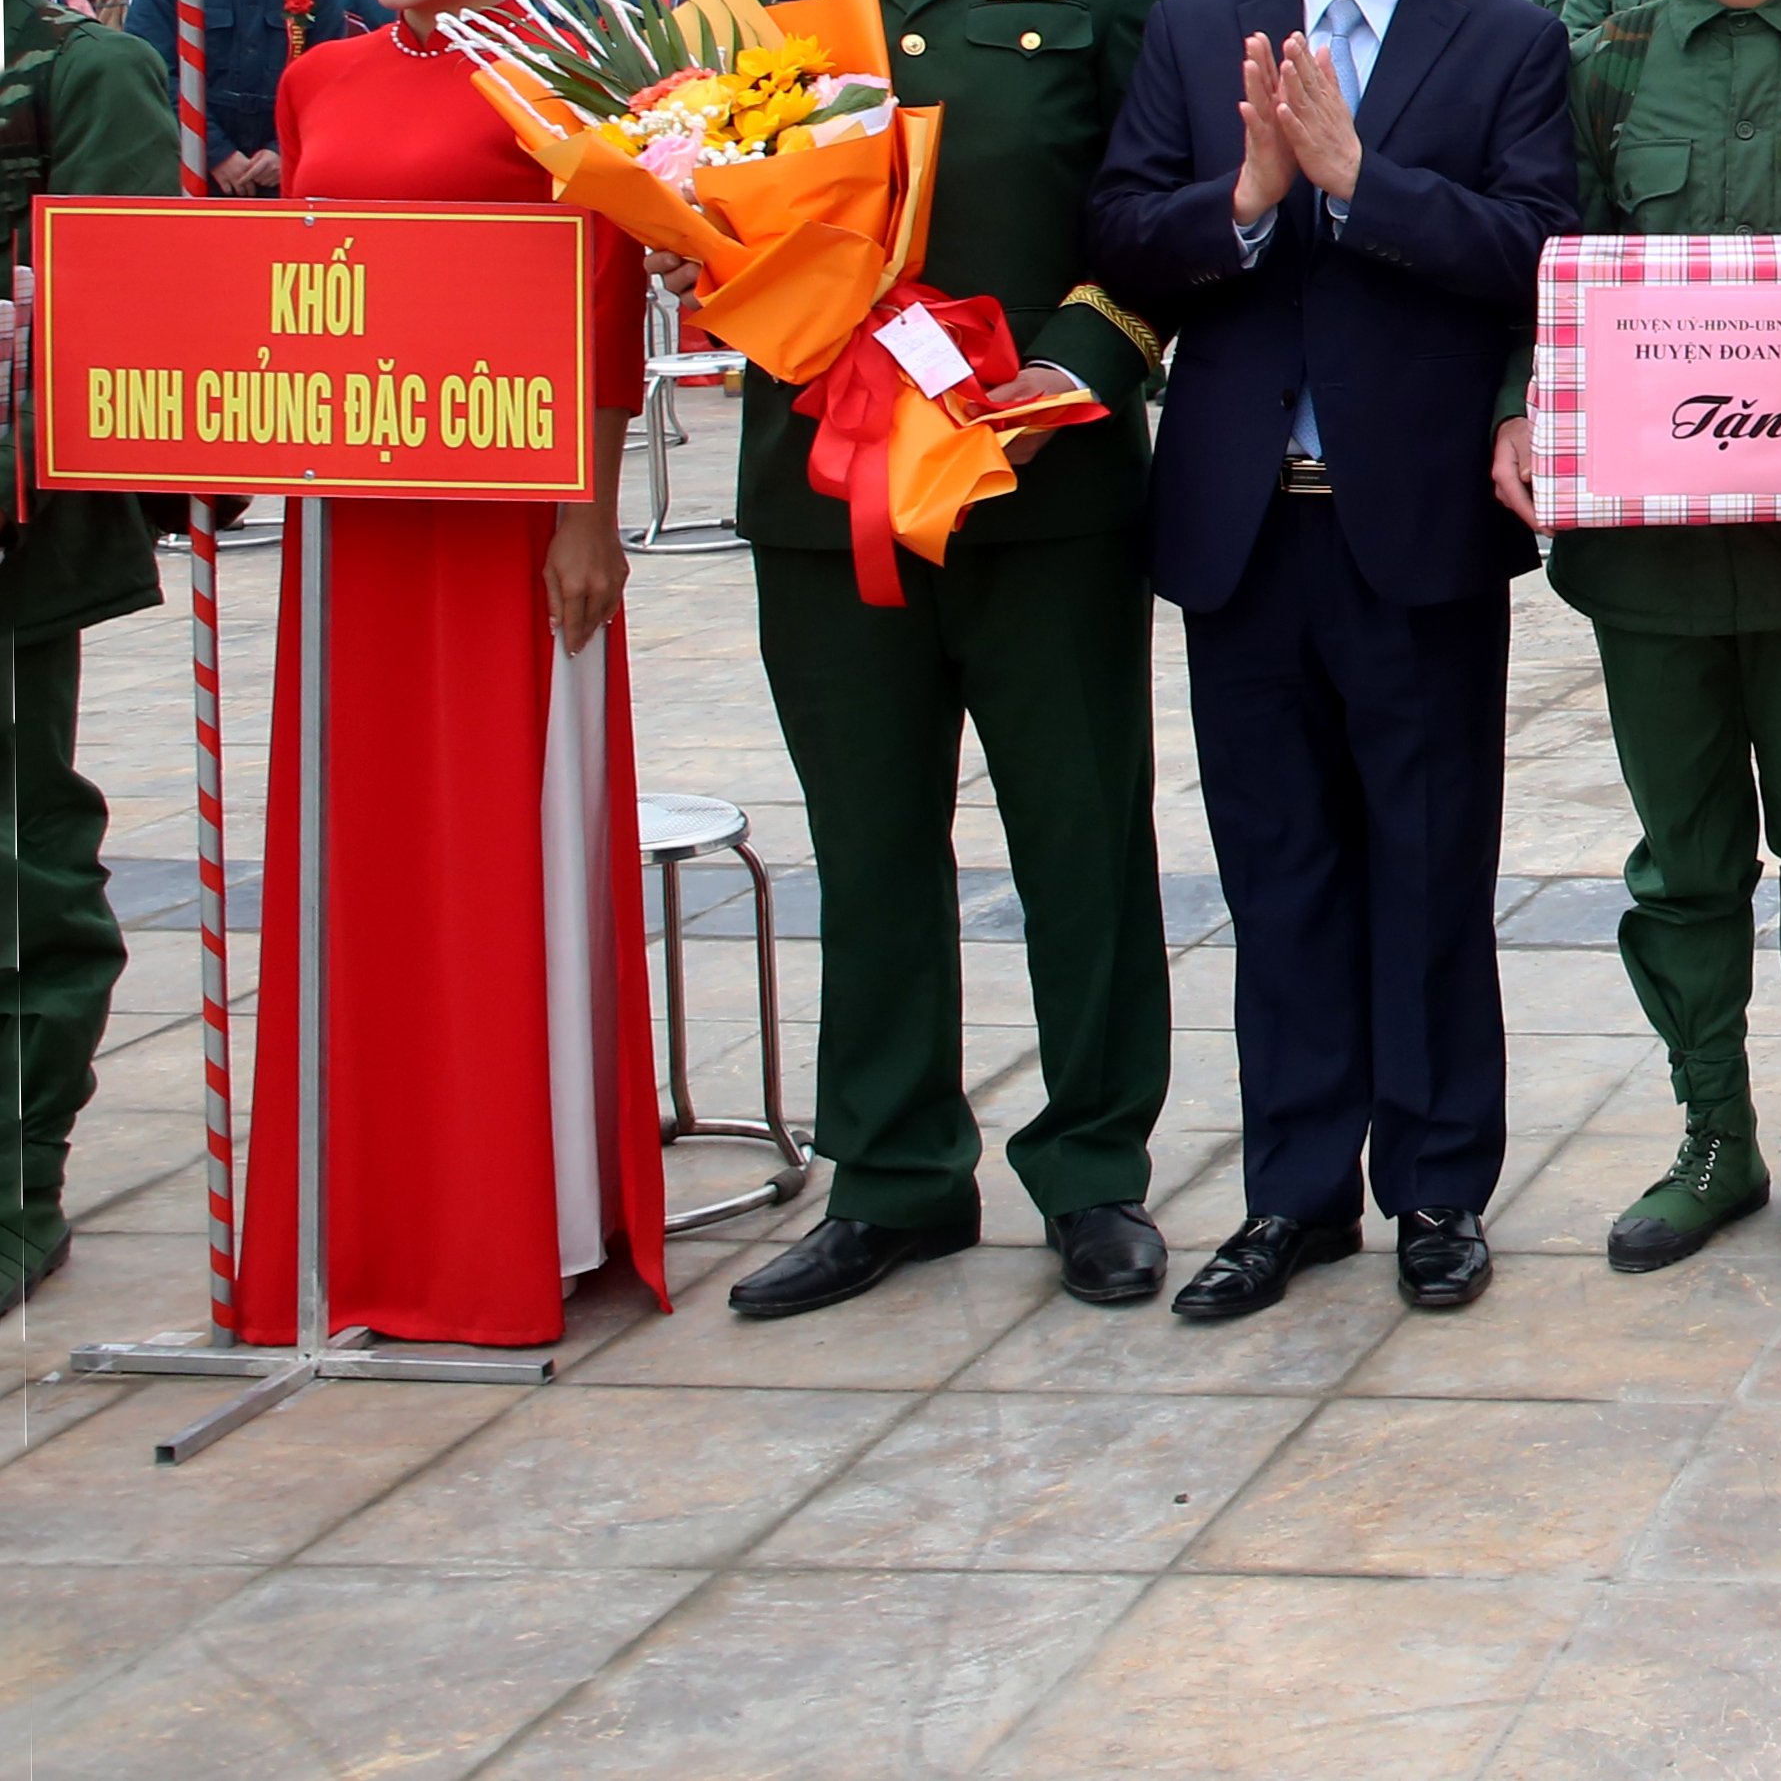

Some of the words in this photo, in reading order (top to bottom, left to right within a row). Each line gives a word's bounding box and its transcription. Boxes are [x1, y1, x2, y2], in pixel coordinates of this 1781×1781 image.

[271, 237, 365, 336] KHỐI
[1616, 317, 1672, 334] HUYỆN
[1635, 341, 1713, 364] HUYỆN
[1719, 343, 1781, 360] ĐOAN
[88, 367, 184, 441] BINH
[196, 346, 333, 446] CHỦNG
[344, 358, 427, 463] ĐẶC
[440, 360, 554, 450] CÔNG
